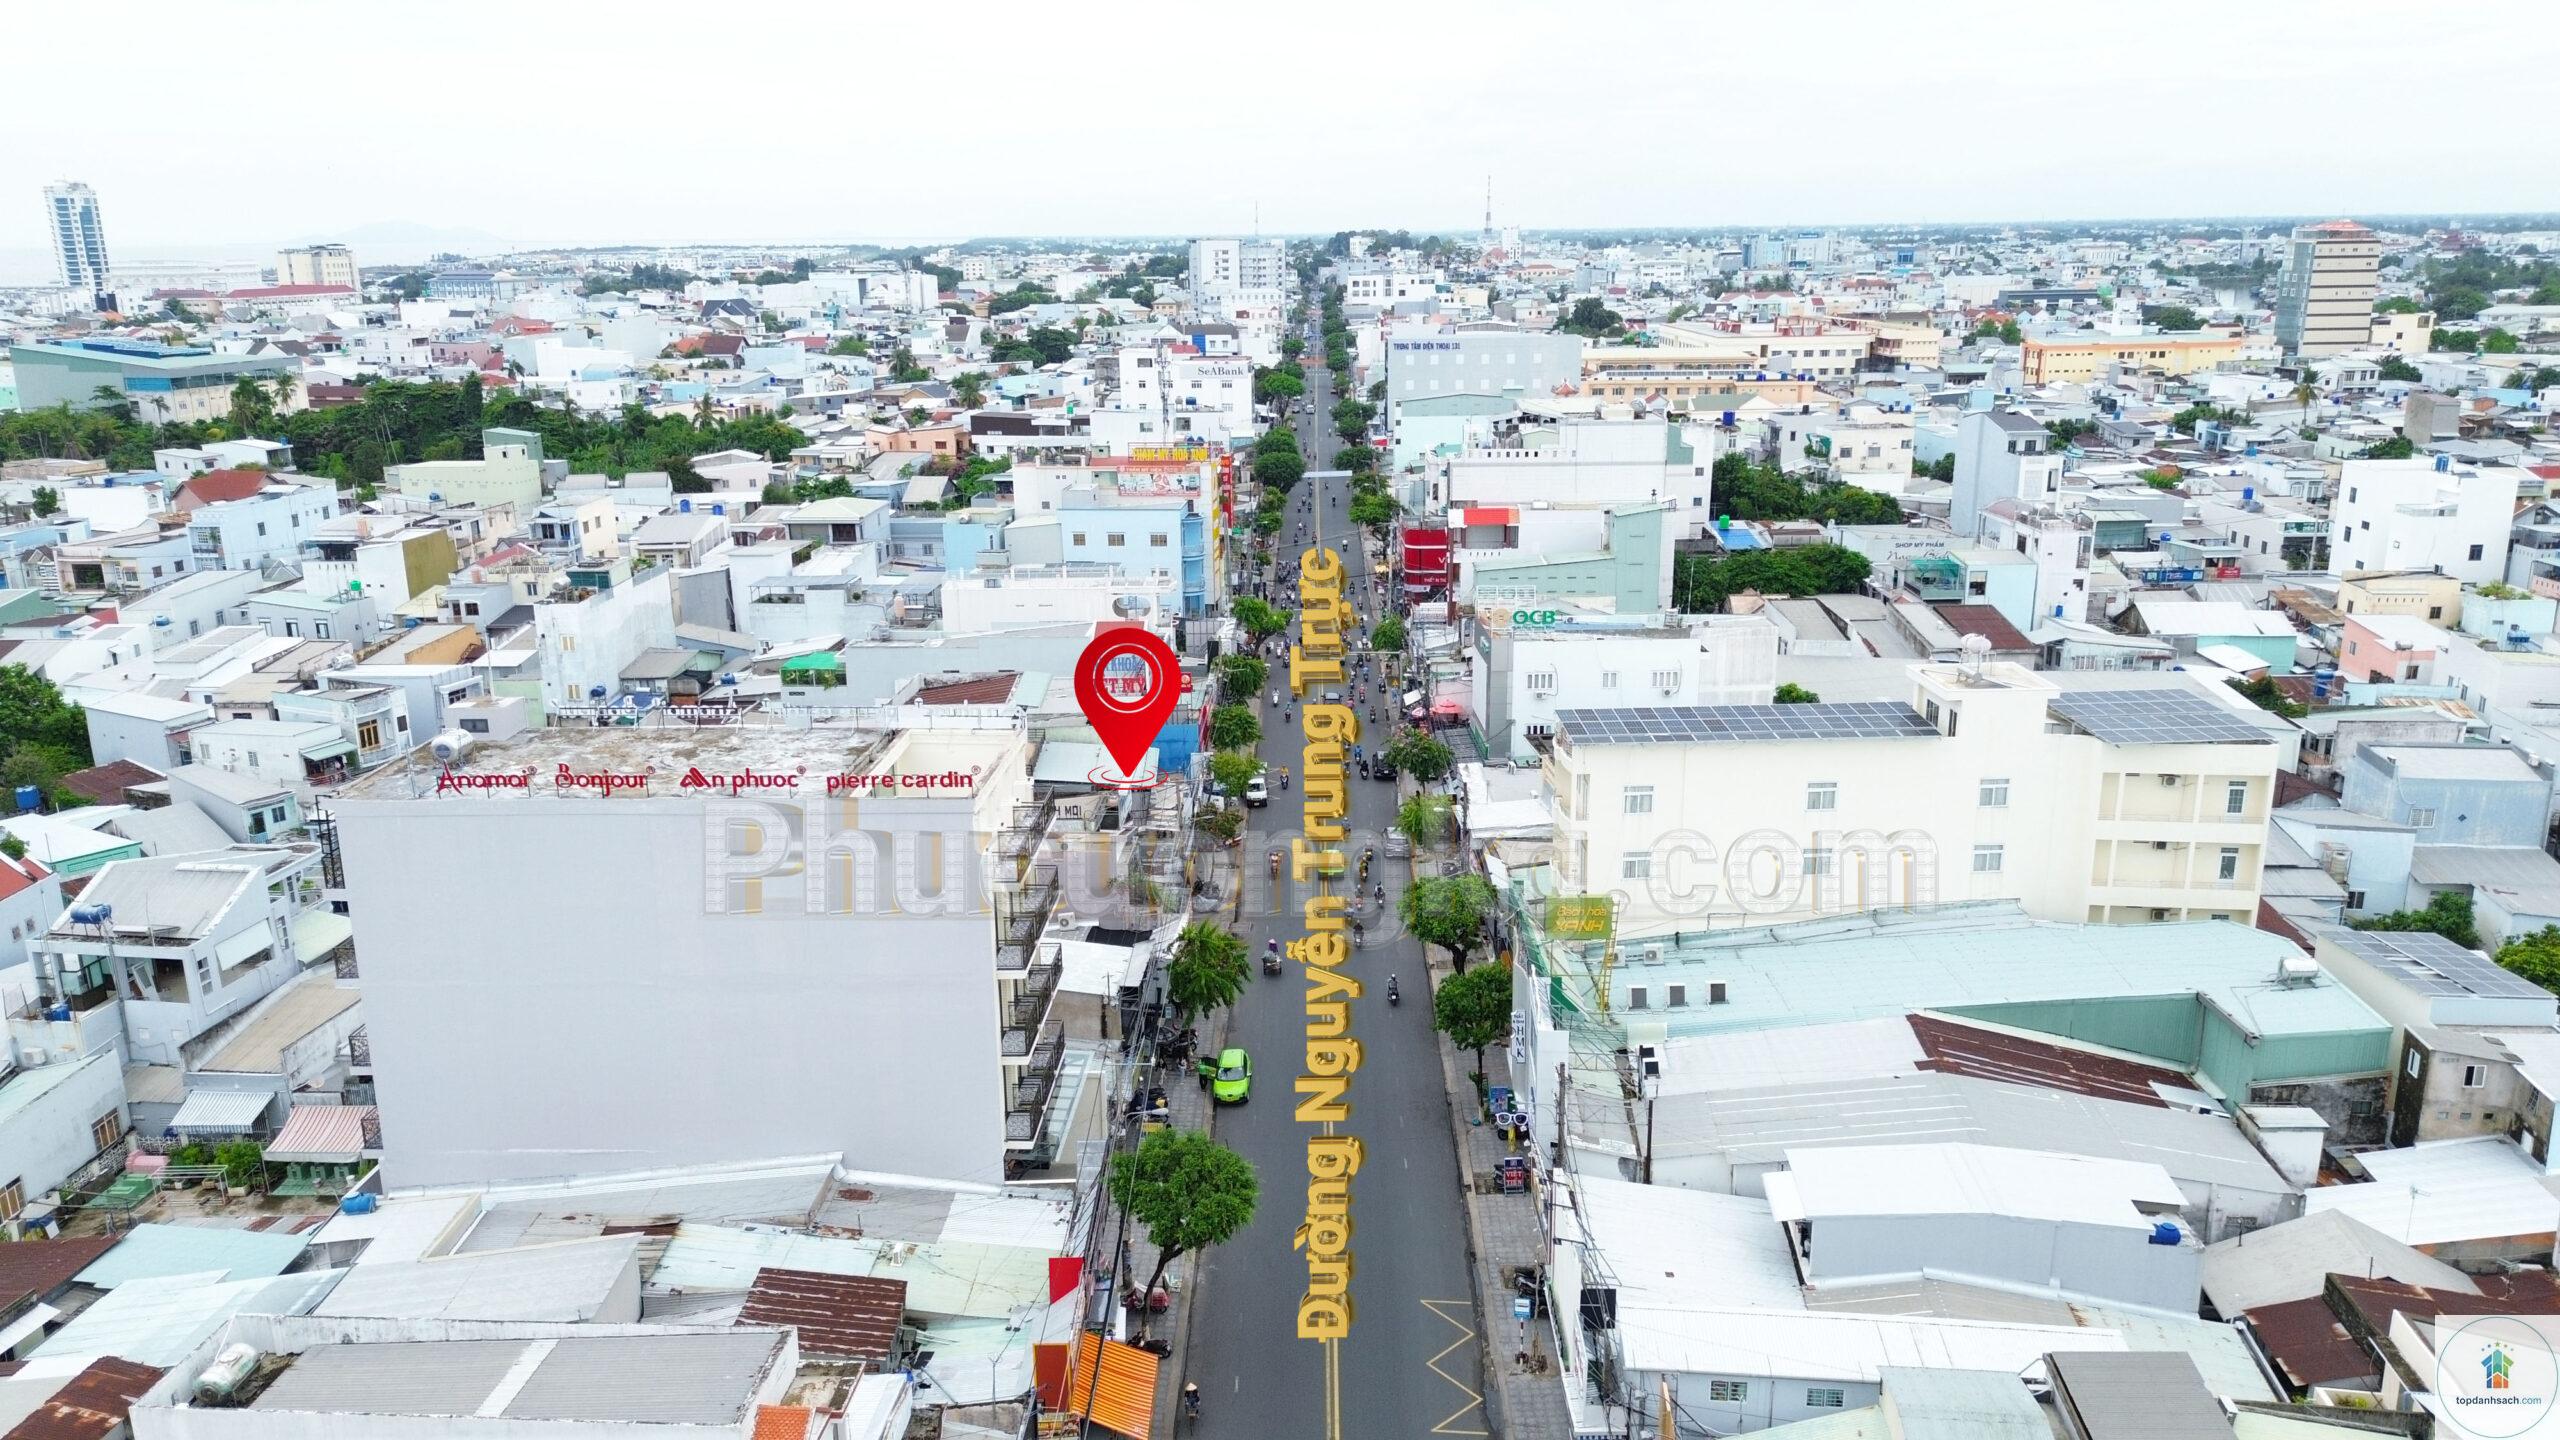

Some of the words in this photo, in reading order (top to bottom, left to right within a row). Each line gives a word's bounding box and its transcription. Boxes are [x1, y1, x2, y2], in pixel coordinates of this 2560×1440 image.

[1197, 366, 1244, 376] SeABank
[1512, 610, 1556, 625] OCB
[827, 772, 895, 794] pierre
[1554, 919, 1605, 932] XANH
